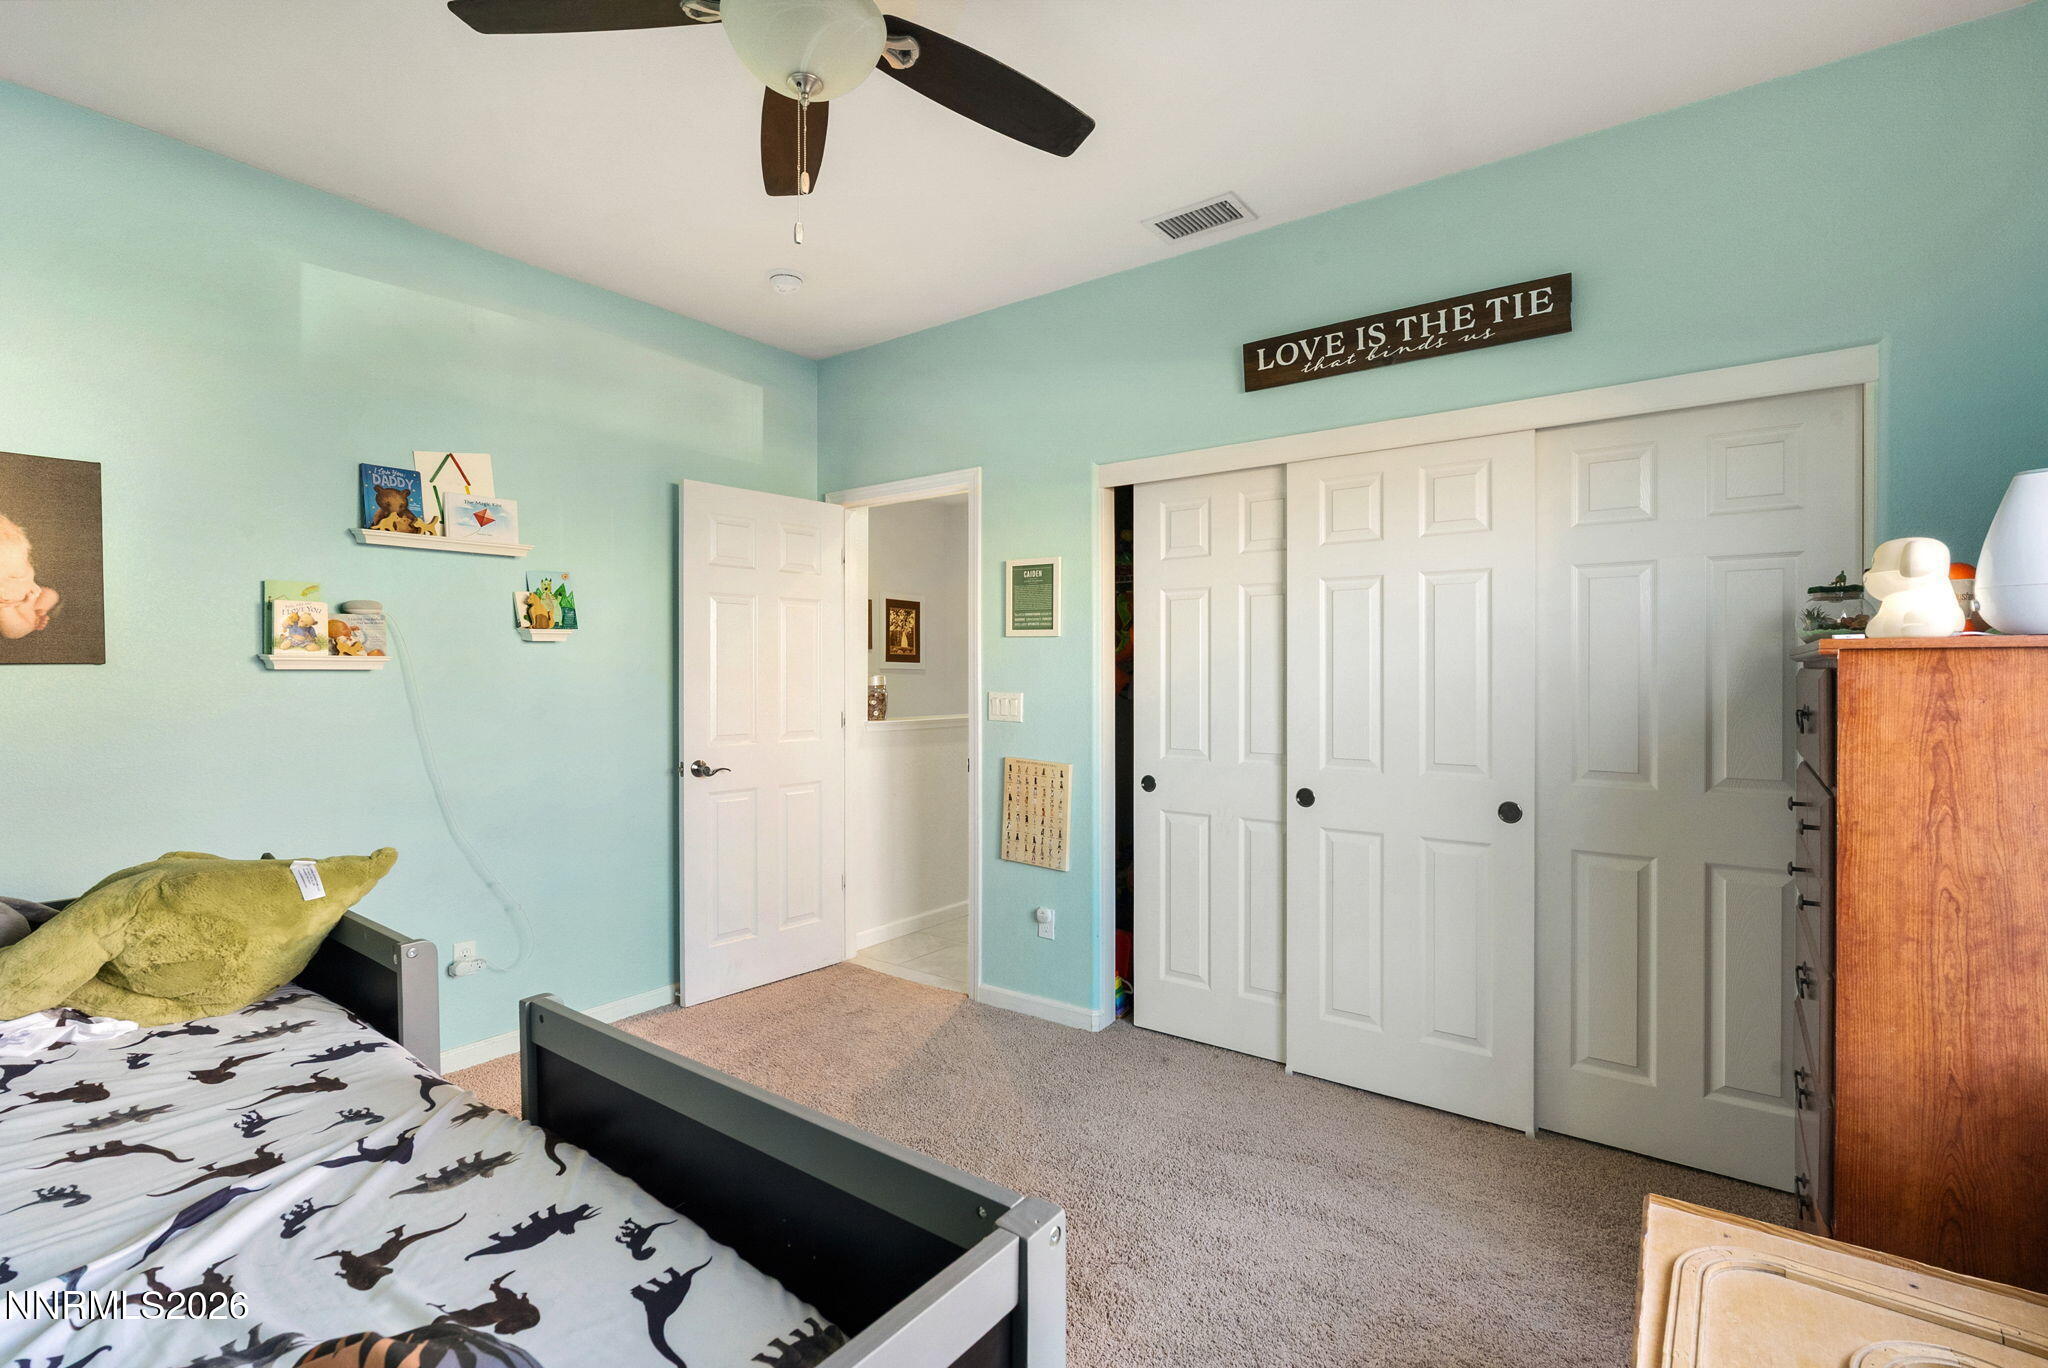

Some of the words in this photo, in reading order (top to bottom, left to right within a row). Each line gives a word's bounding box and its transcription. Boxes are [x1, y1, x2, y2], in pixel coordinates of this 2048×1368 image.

[1256, 331, 1345, 371] LOVE
[1357, 322, 1387, 351] IS
[1395, 303, 1476, 342] THE
[1485, 286, 1555, 324] TIE
[1300, 353, 1357, 373] that
[1365, 334, 1449, 362] binds
[1458, 327, 1496, 343] us
[372, 473, 414, 491] DADDY
